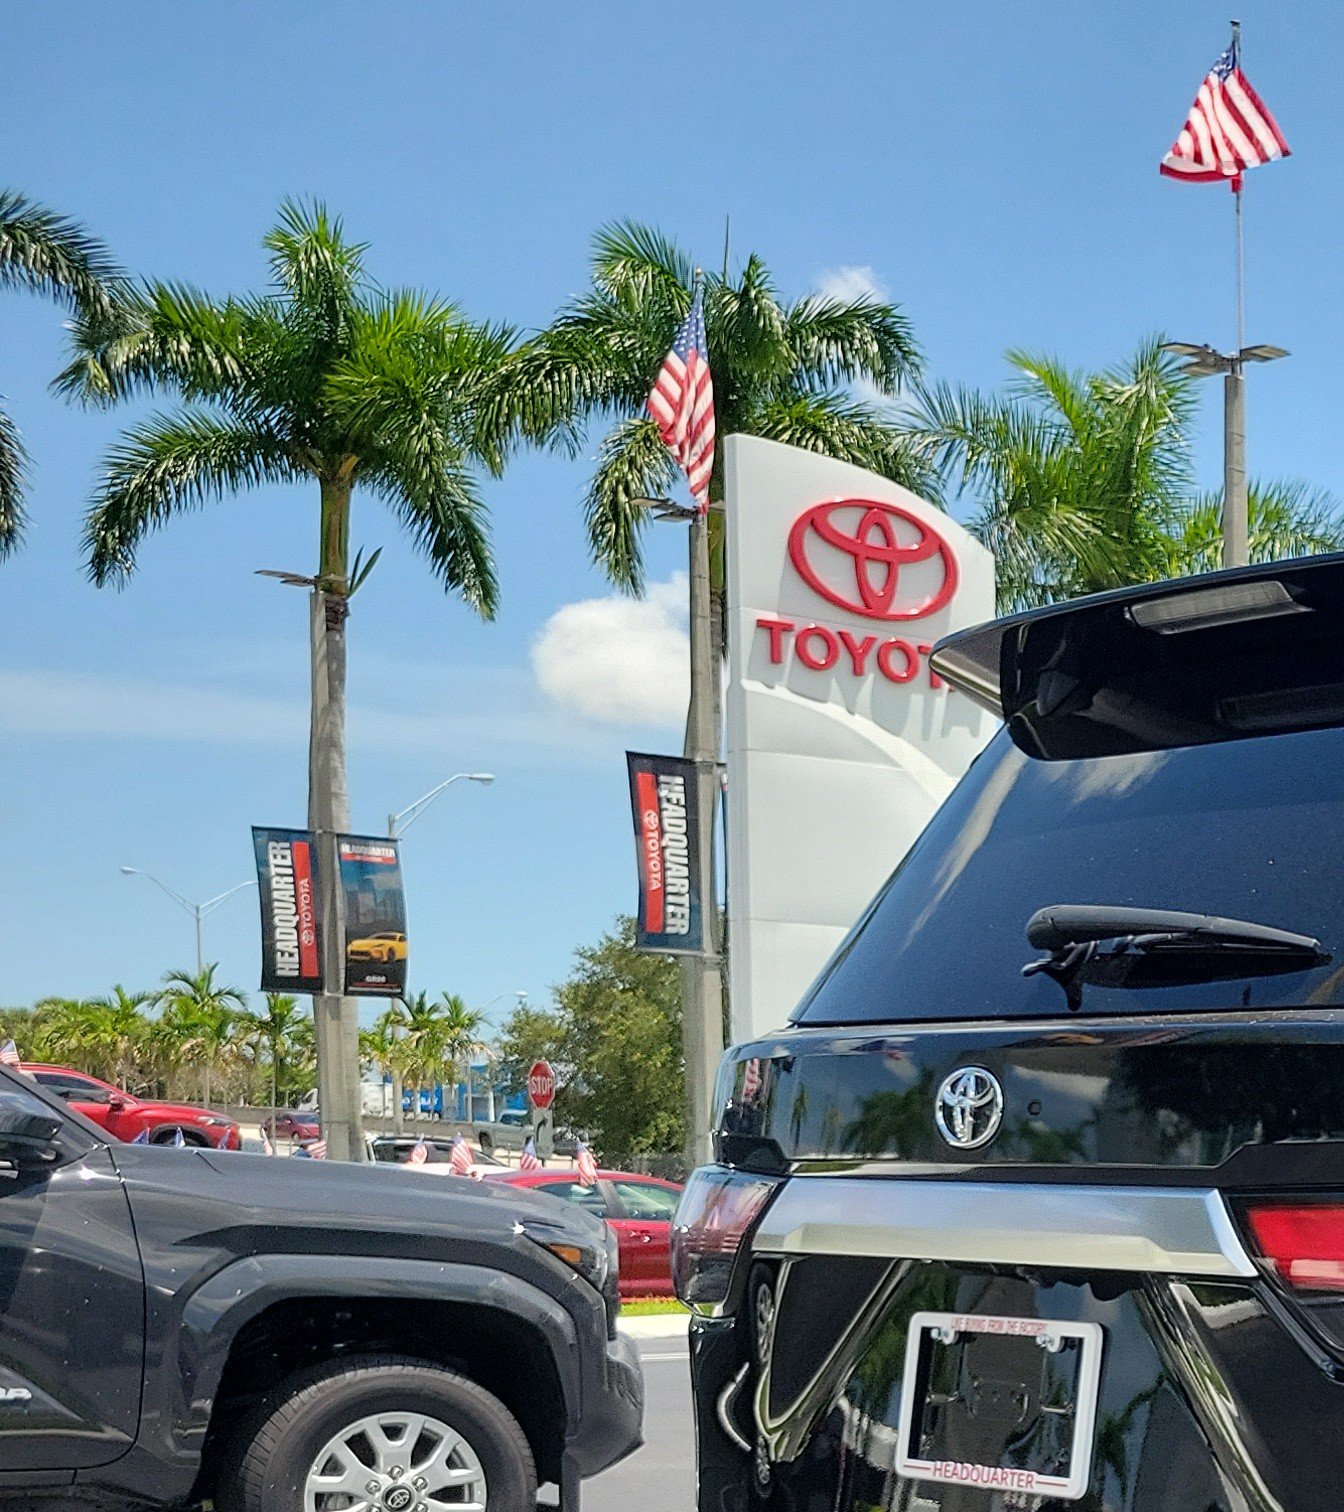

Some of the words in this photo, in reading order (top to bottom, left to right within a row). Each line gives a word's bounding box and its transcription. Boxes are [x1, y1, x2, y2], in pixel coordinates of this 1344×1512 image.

[756, 618, 957, 692] TOYO
[645, 829, 663, 892] TOYOTA
[658, 774, 691, 936] HEADQUARTER
[268, 841, 300, 977] HEADQUARTER
[300, 877, 313, 928] TOYOTA
[531, 1076, 553, 1094] STOP
[932, 1461, 1035, 1488] HEADQUARTER
